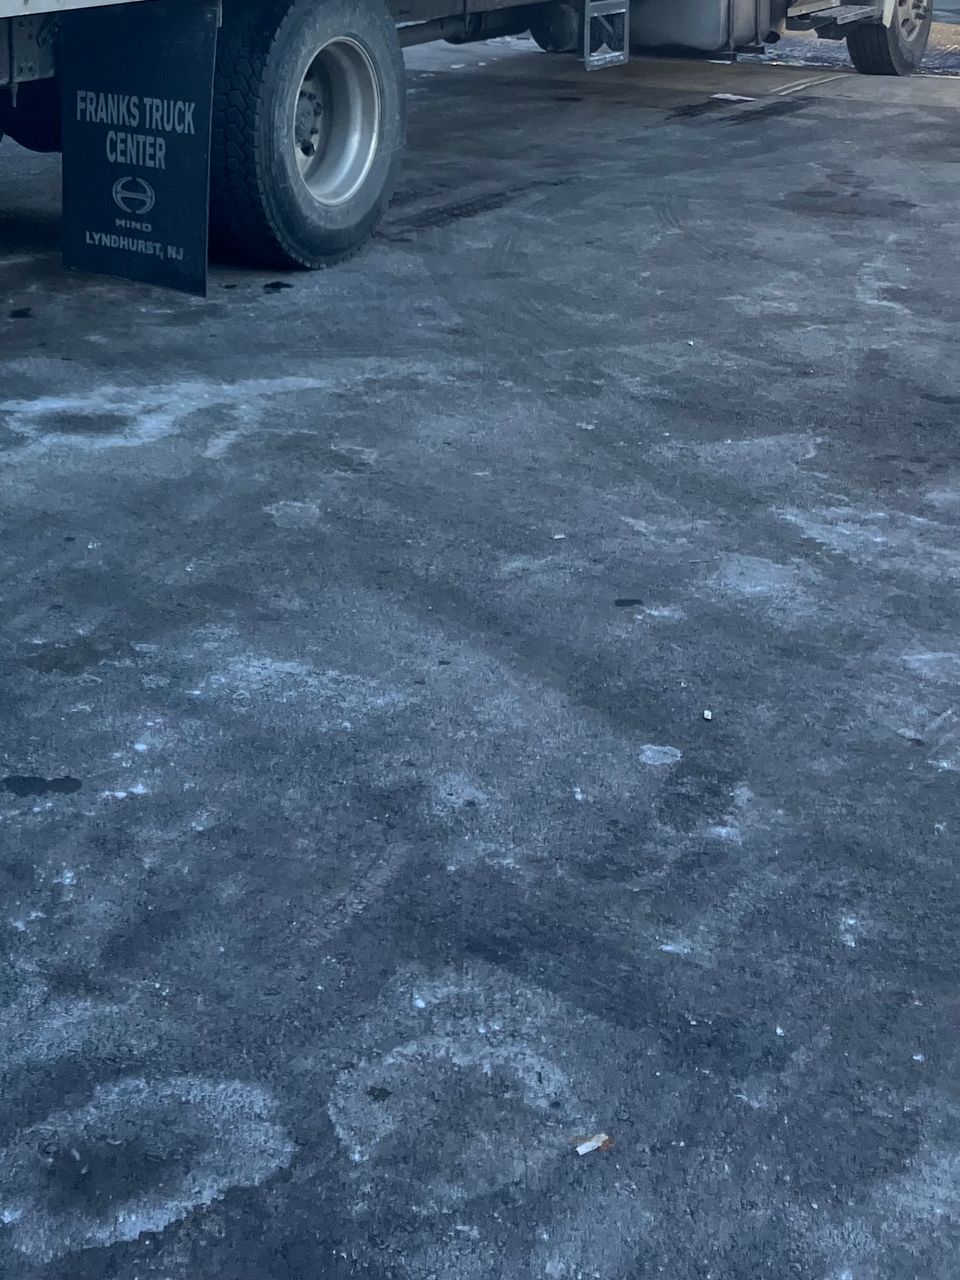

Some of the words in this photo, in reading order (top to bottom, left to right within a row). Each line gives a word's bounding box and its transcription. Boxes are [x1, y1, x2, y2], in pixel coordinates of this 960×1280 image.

[76, 90, 140, 128] FRANKS
[144, 97, 196, 135] TRUCK
[106, 130, 167, 170] CENTER
[86, 231, 164, 260] LYNDHURST,
[167, 244, 184, 260] NJ
